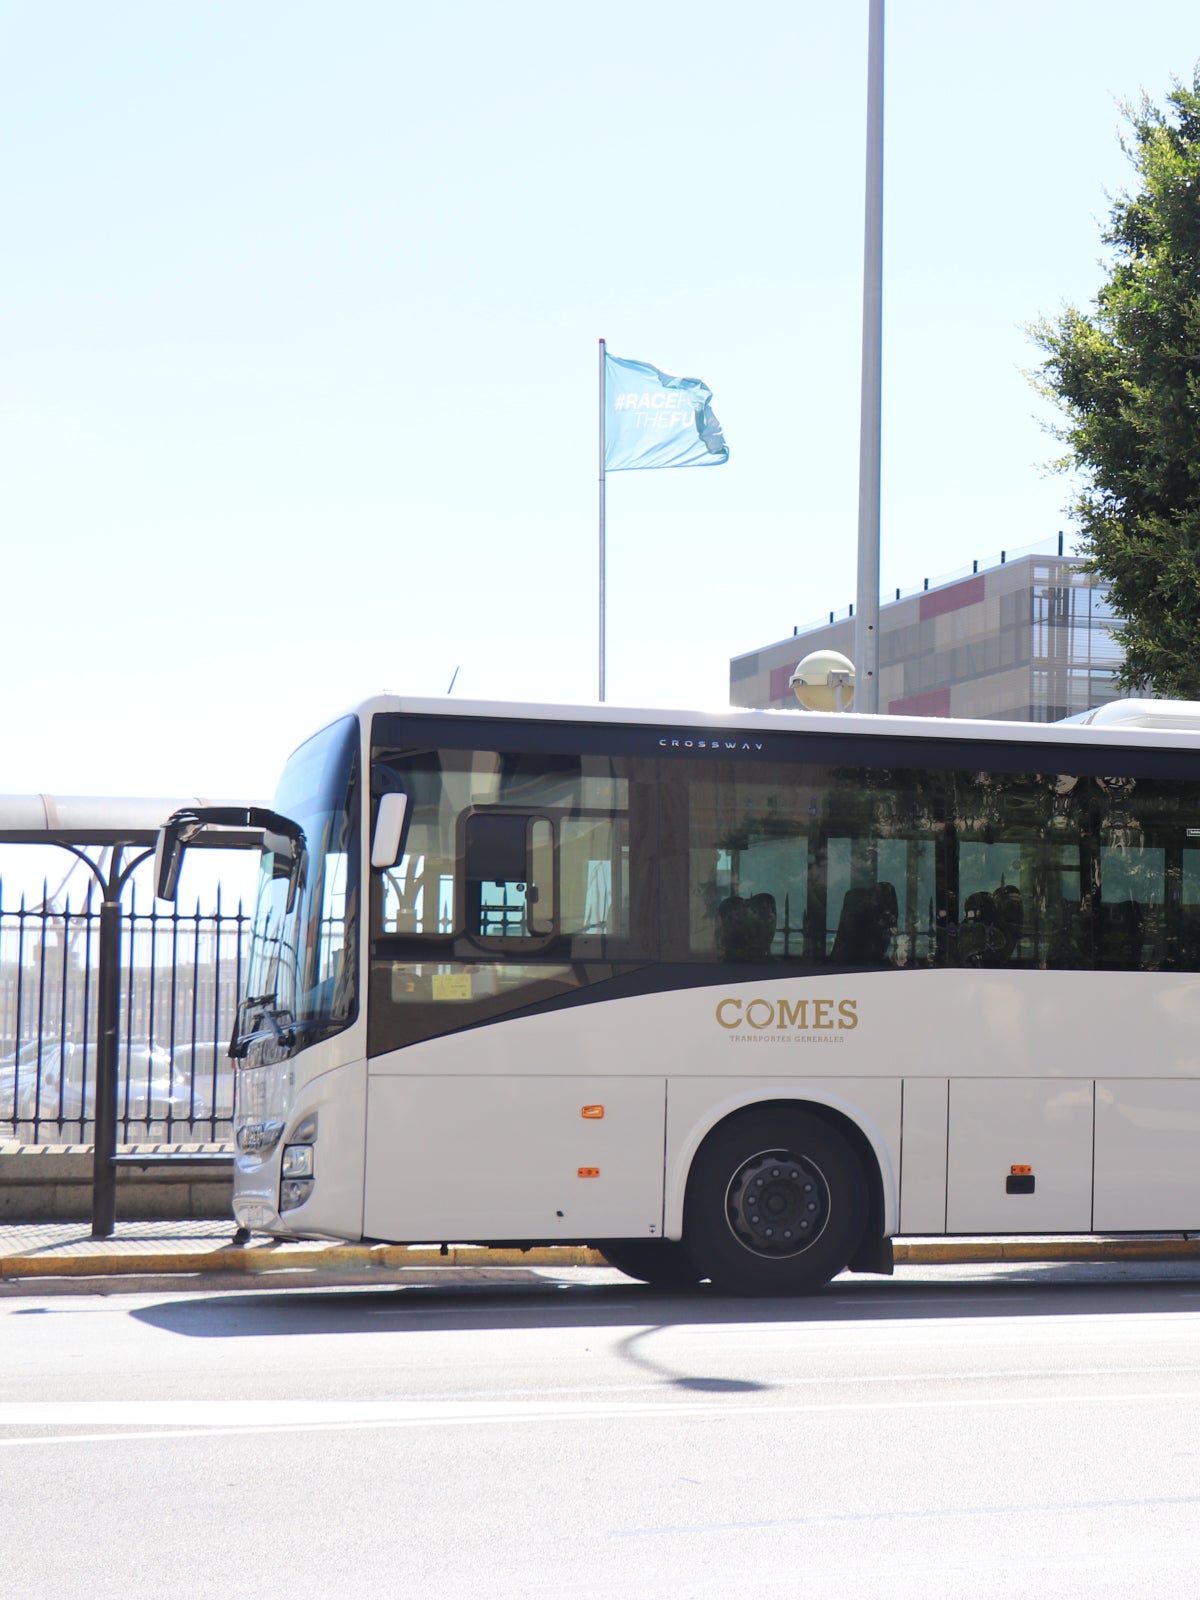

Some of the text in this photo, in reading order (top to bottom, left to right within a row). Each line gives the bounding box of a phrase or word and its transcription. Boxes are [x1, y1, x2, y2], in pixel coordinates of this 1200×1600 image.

[715, 998, 858, 1030] COMES
[730, 1035, 844, 1043] TRANSPORTES GENERALES
